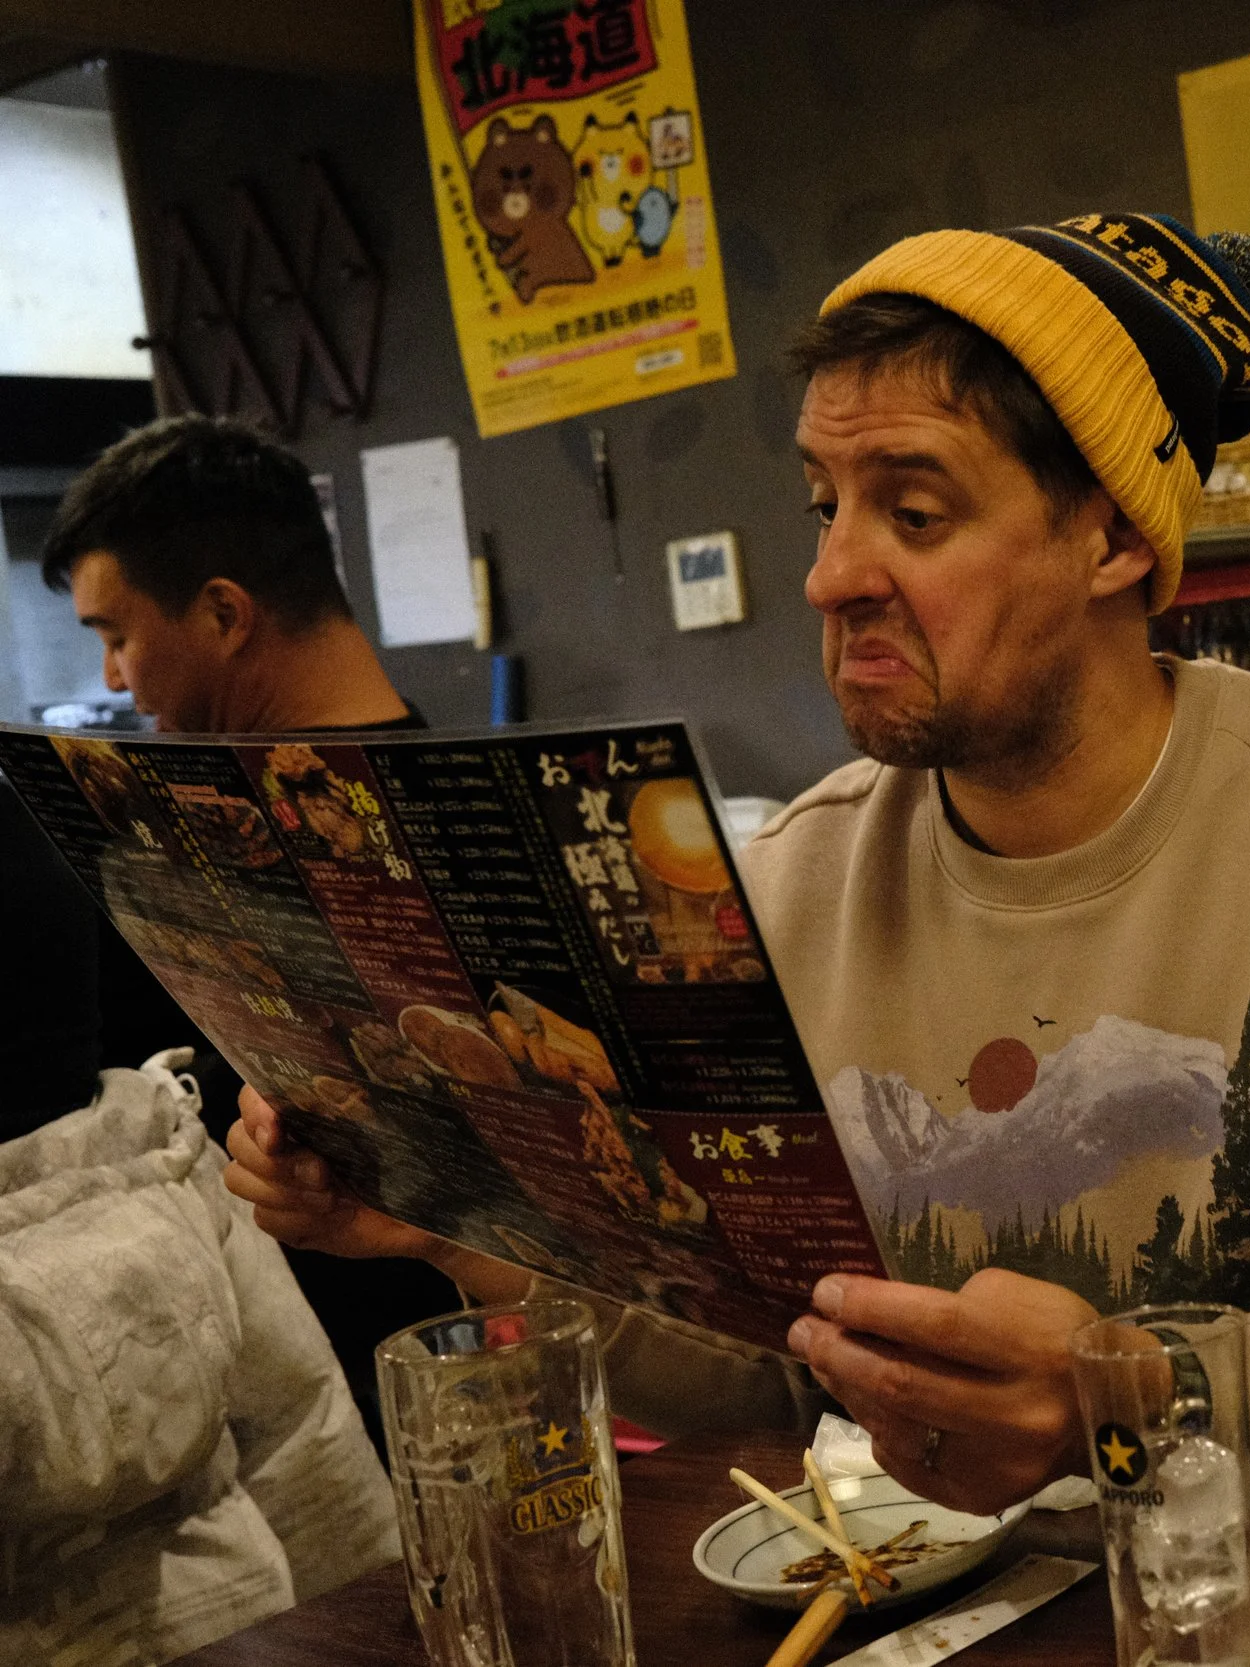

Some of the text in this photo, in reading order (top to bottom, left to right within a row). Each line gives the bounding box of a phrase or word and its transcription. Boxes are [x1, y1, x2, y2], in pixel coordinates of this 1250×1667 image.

[345, 781, 413, 881] 揚げ物
[689, 1124, 786, 1162] お食事
[510, 1476, 604, 1534] CLASSIC
